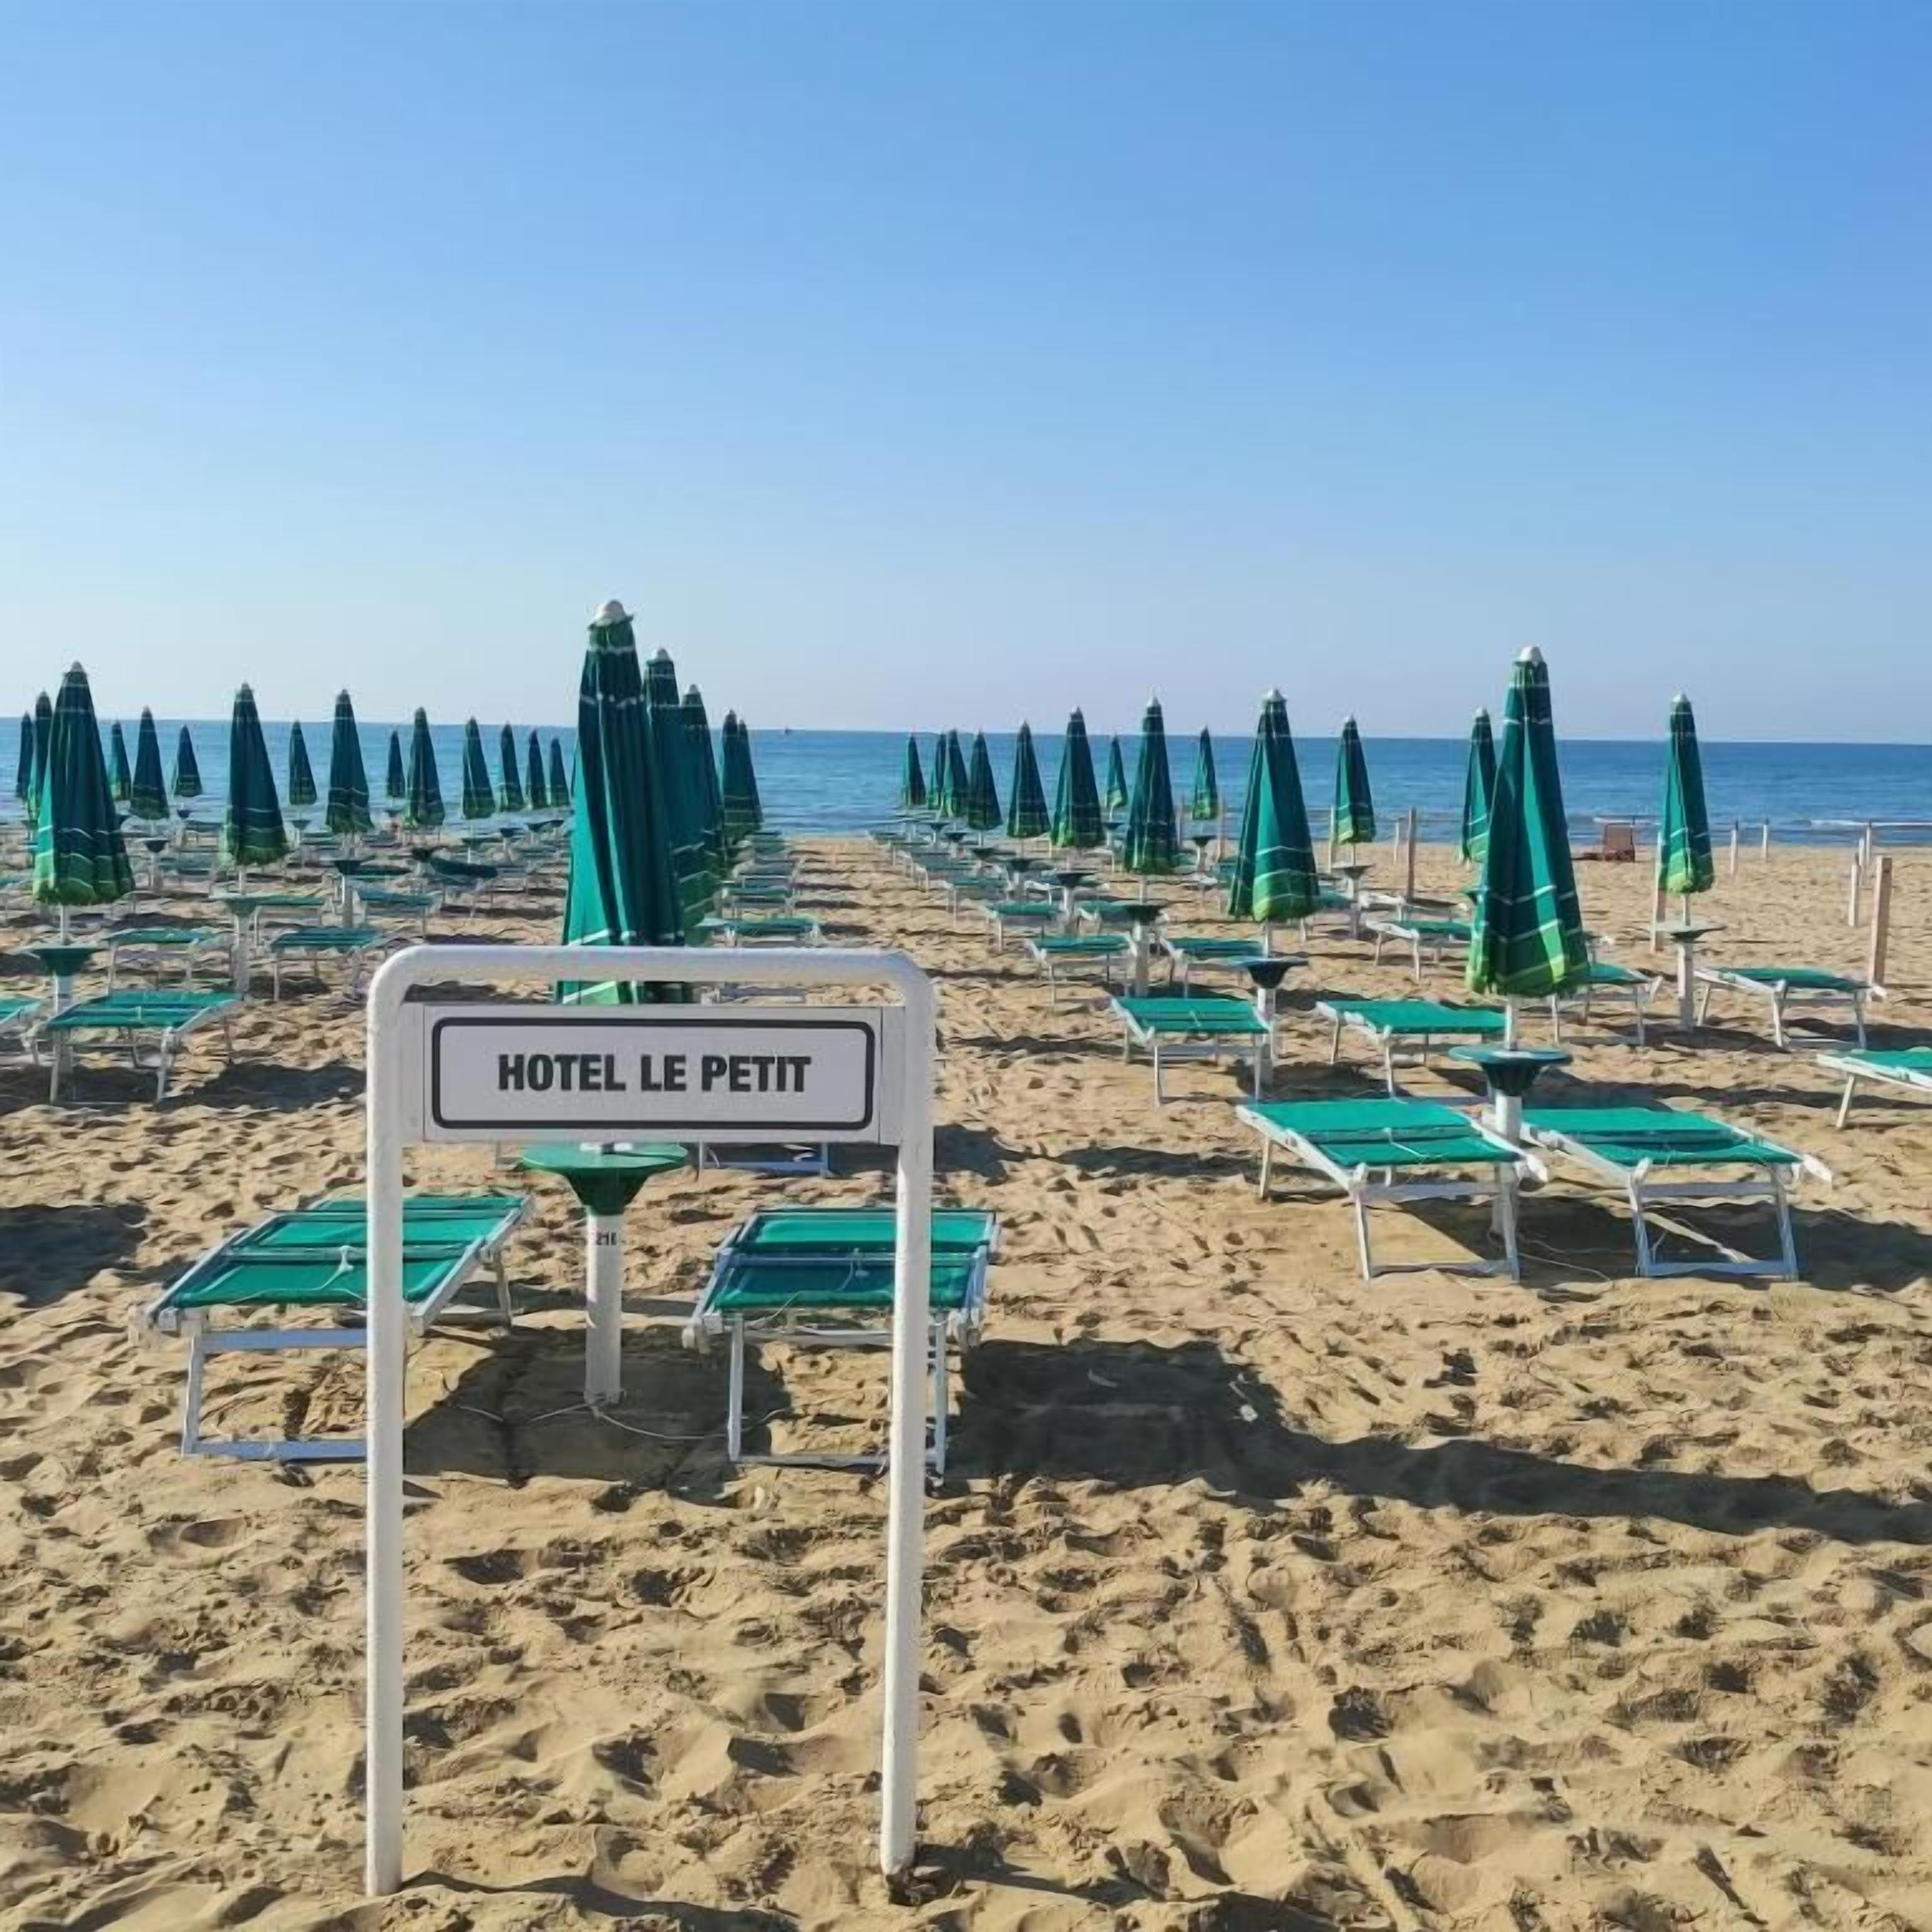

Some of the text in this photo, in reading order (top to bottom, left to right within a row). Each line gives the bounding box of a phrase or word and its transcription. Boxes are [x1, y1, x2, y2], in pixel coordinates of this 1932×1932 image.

[498, 1053, 812, 1092] HOTEL LE PETIT
